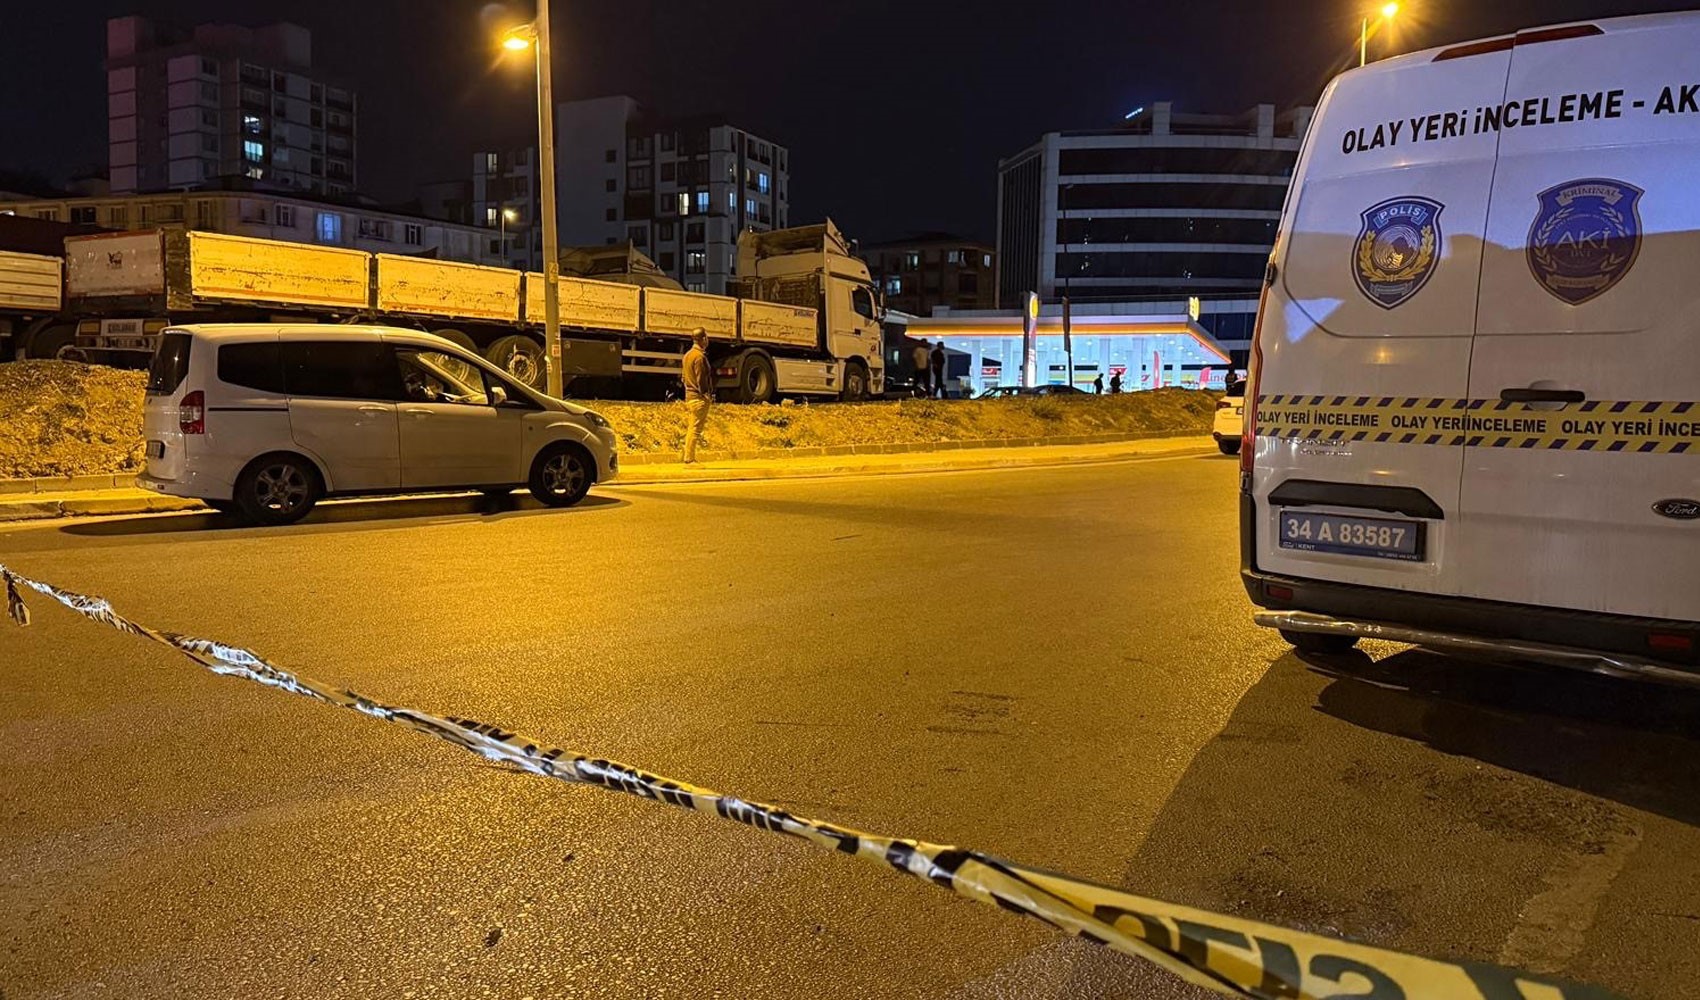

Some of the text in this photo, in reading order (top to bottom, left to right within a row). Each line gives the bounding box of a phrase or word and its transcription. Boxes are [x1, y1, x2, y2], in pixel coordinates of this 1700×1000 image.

[1342, 119, 1404, 154] OLAY
[1652, 84, 1700, 115] AK
[1380, 206, 1421, 220] POLİS
[1555, 227, 1612, 249] AKİ
[1257, 410, 1379, 427] OLAY YERİ İNCELEME
[1391, 415, 1428, 429] OLAY
[1561, 420, 1606, 435] OLAY
[1611, 419, 1652, 436] YERİ
[1287, 518, 1405, 549] 34 A 83587
